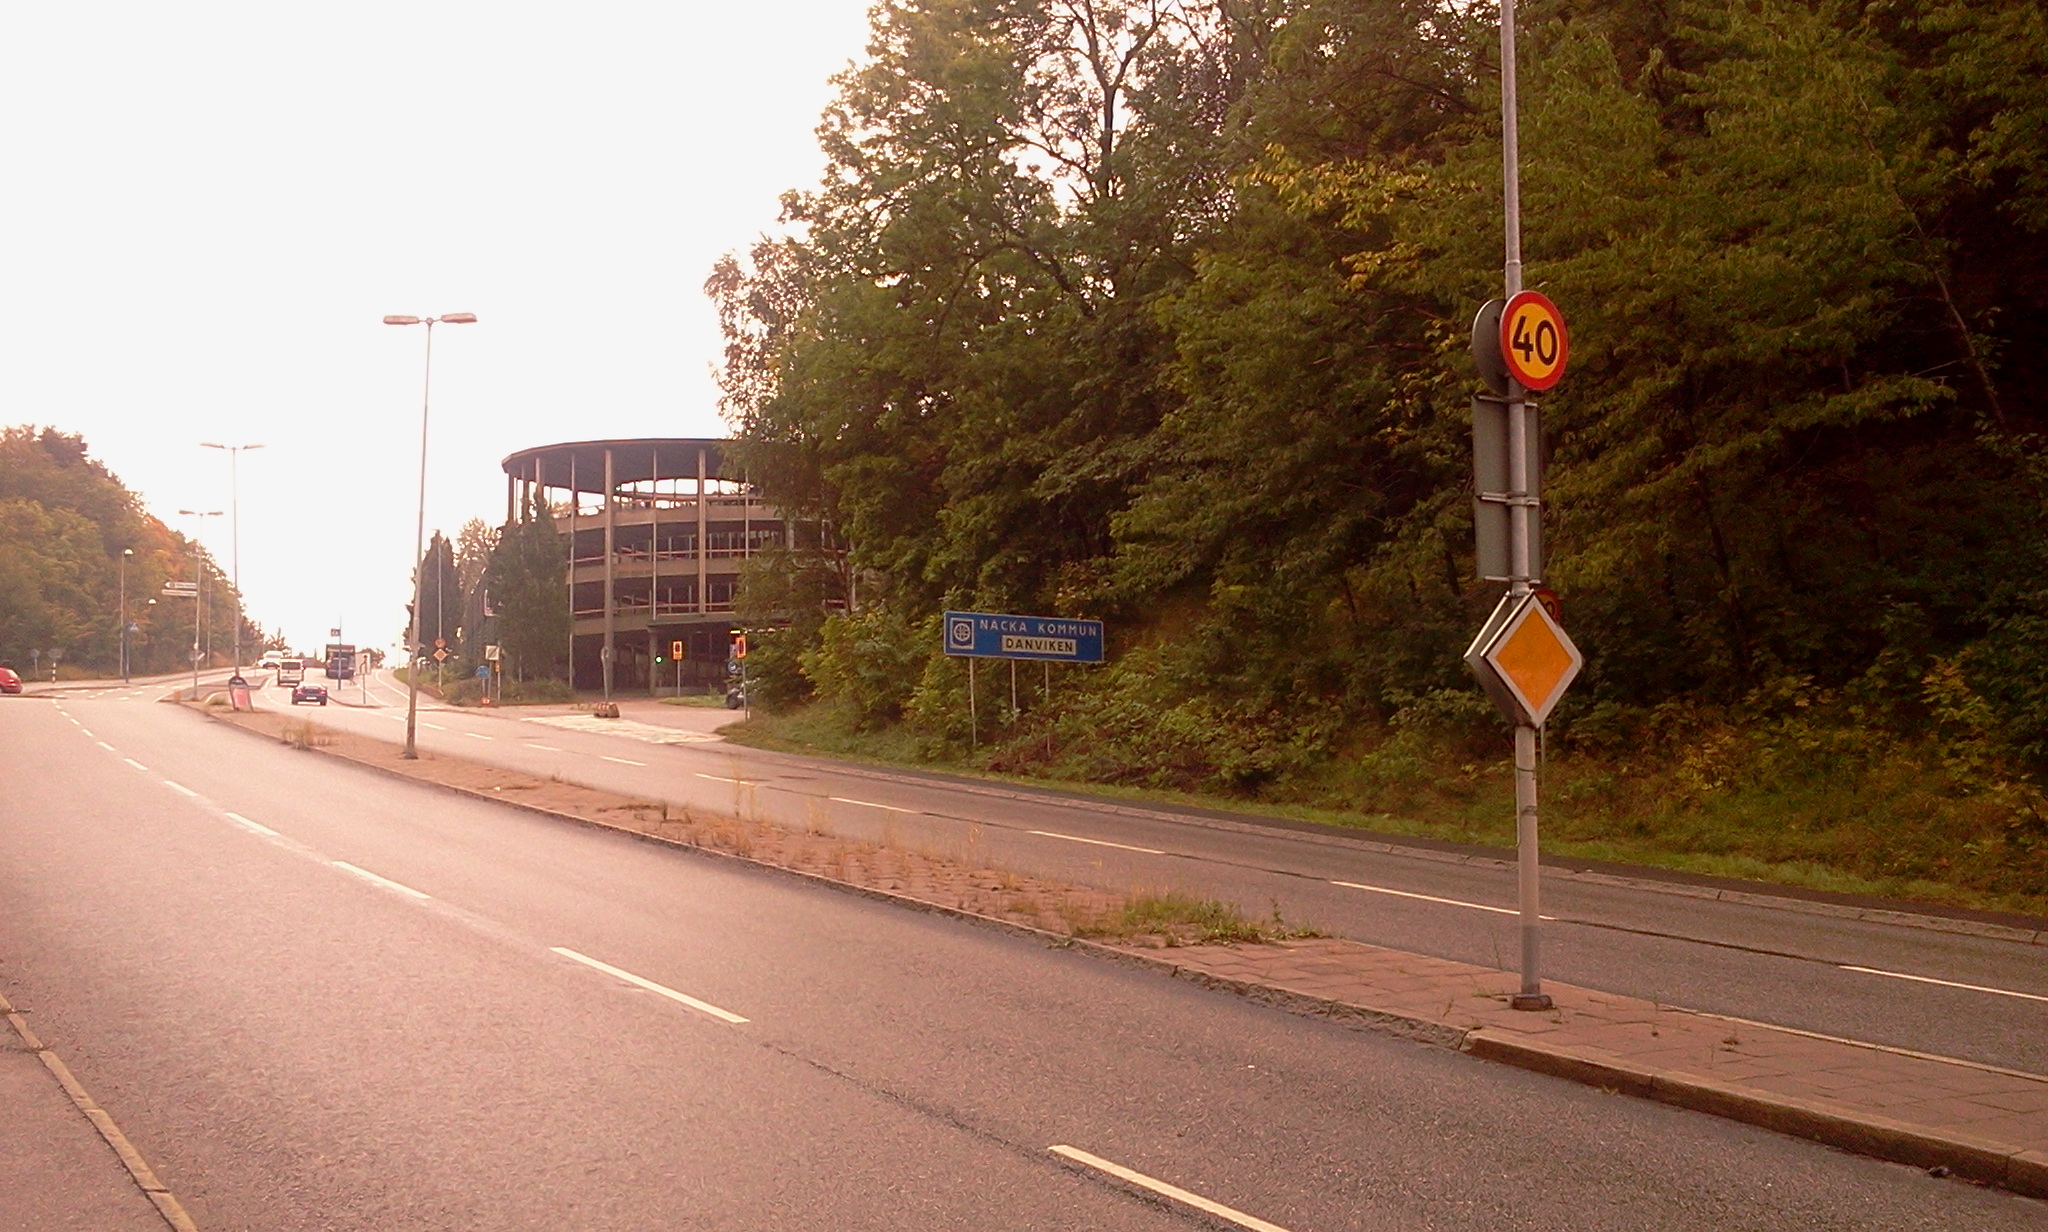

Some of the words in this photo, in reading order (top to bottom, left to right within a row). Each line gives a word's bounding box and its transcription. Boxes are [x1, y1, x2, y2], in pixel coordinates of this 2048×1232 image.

[1512, 316, 1558, 366] 40
[980, 619, 1027, 633] NACKA
[1038, 623, 1097, 637] KOMMUN
[1005, 638, 1074, 652] DANVIKEN
